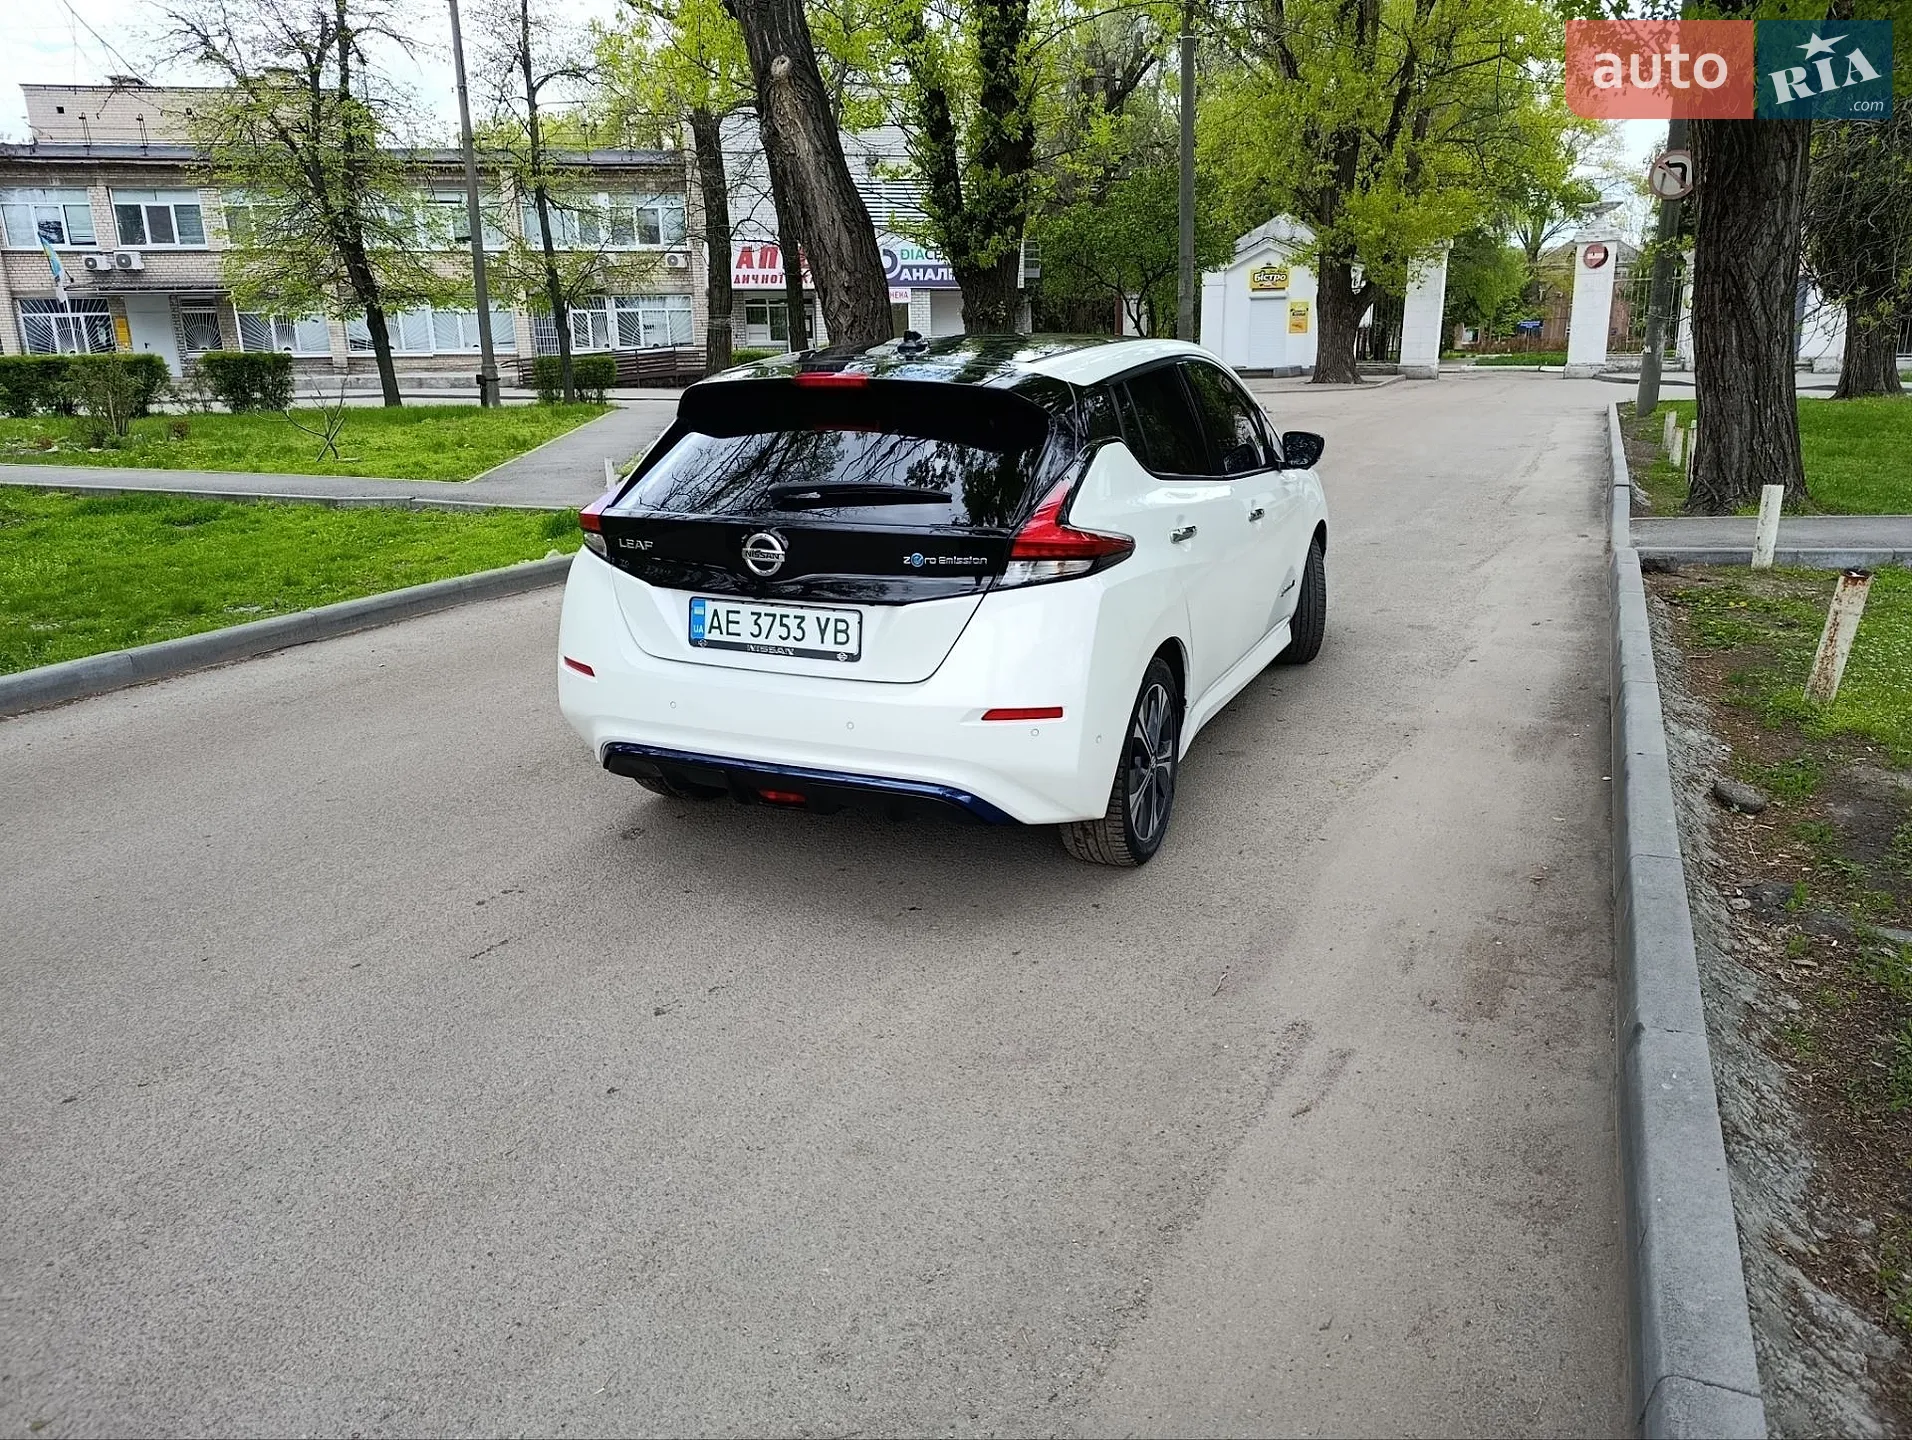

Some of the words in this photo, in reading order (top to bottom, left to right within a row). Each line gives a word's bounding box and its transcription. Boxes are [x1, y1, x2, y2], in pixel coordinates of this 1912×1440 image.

[1254, 271, 1286, 282] Бістро
[618, 538, 654, 551] LEAF
[745, 549, 780, 560] NISSAN
[938, 555, 988, 565] Emission
[693, 624, 704, 634] UA
[708, 608, 741, 637] AE
[749, 611, 806, 642] 3753
[816, 616, 850, 646] YB
[746, 644, 796, 656] NISSAN
